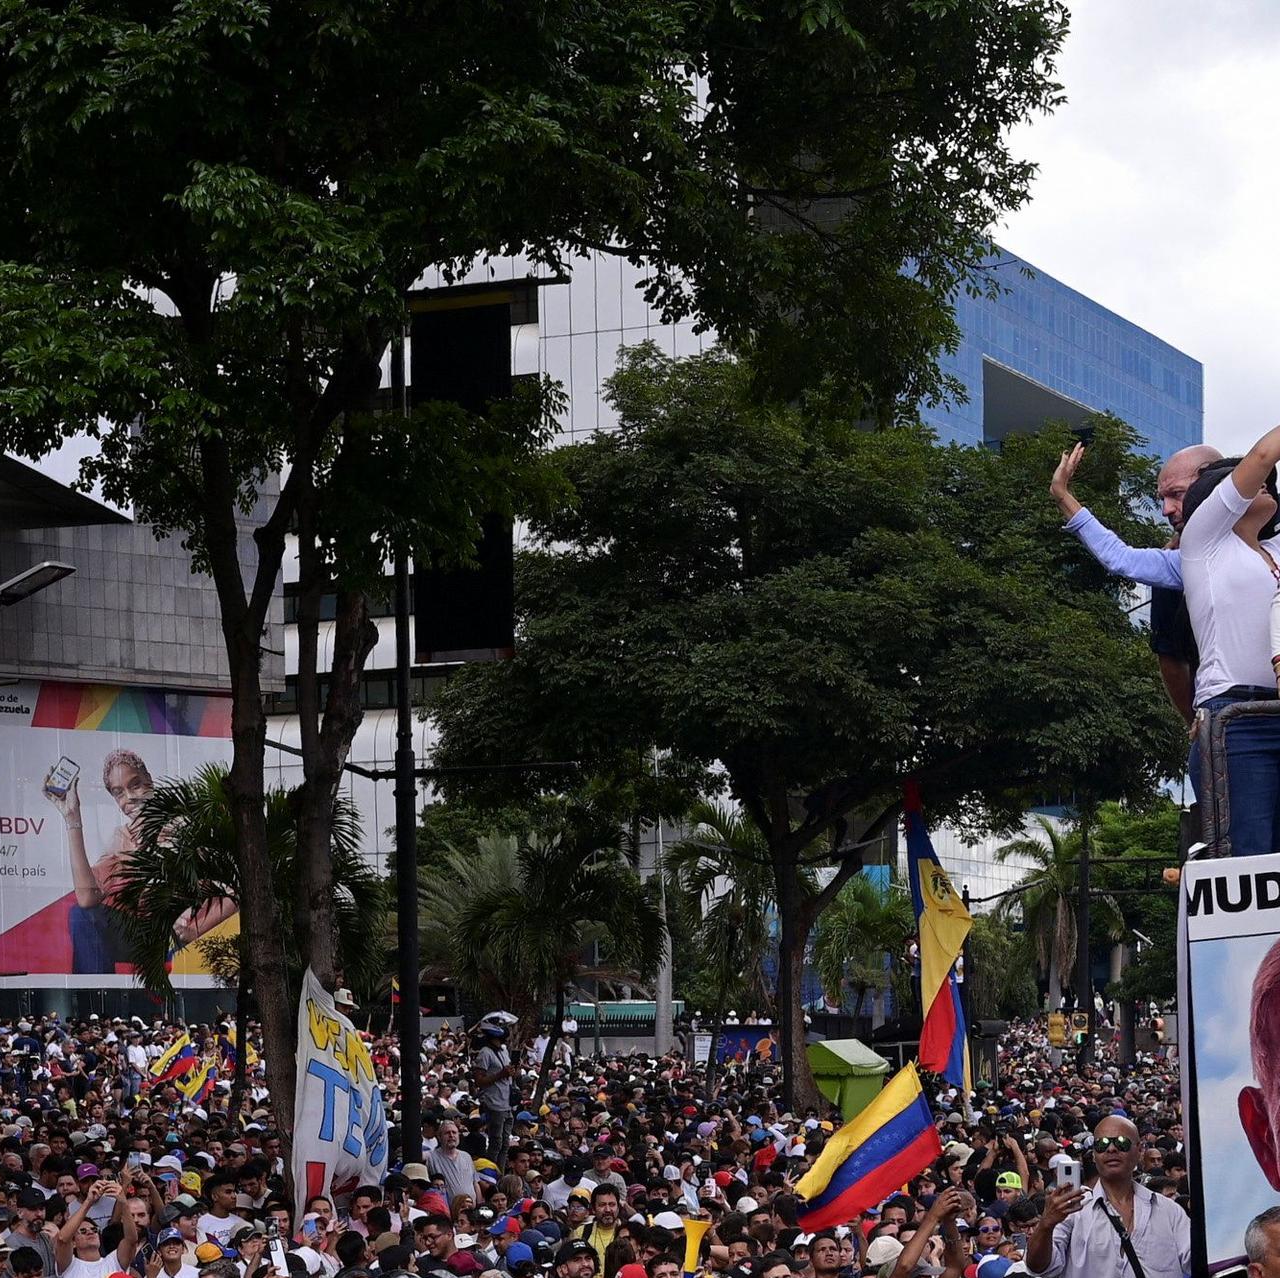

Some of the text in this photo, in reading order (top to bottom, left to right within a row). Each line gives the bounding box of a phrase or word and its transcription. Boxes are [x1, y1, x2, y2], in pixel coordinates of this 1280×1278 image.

[7, 694, 18, 702] de
[0, 864, 18, 876] del
[22, 864, 47, 878] país
